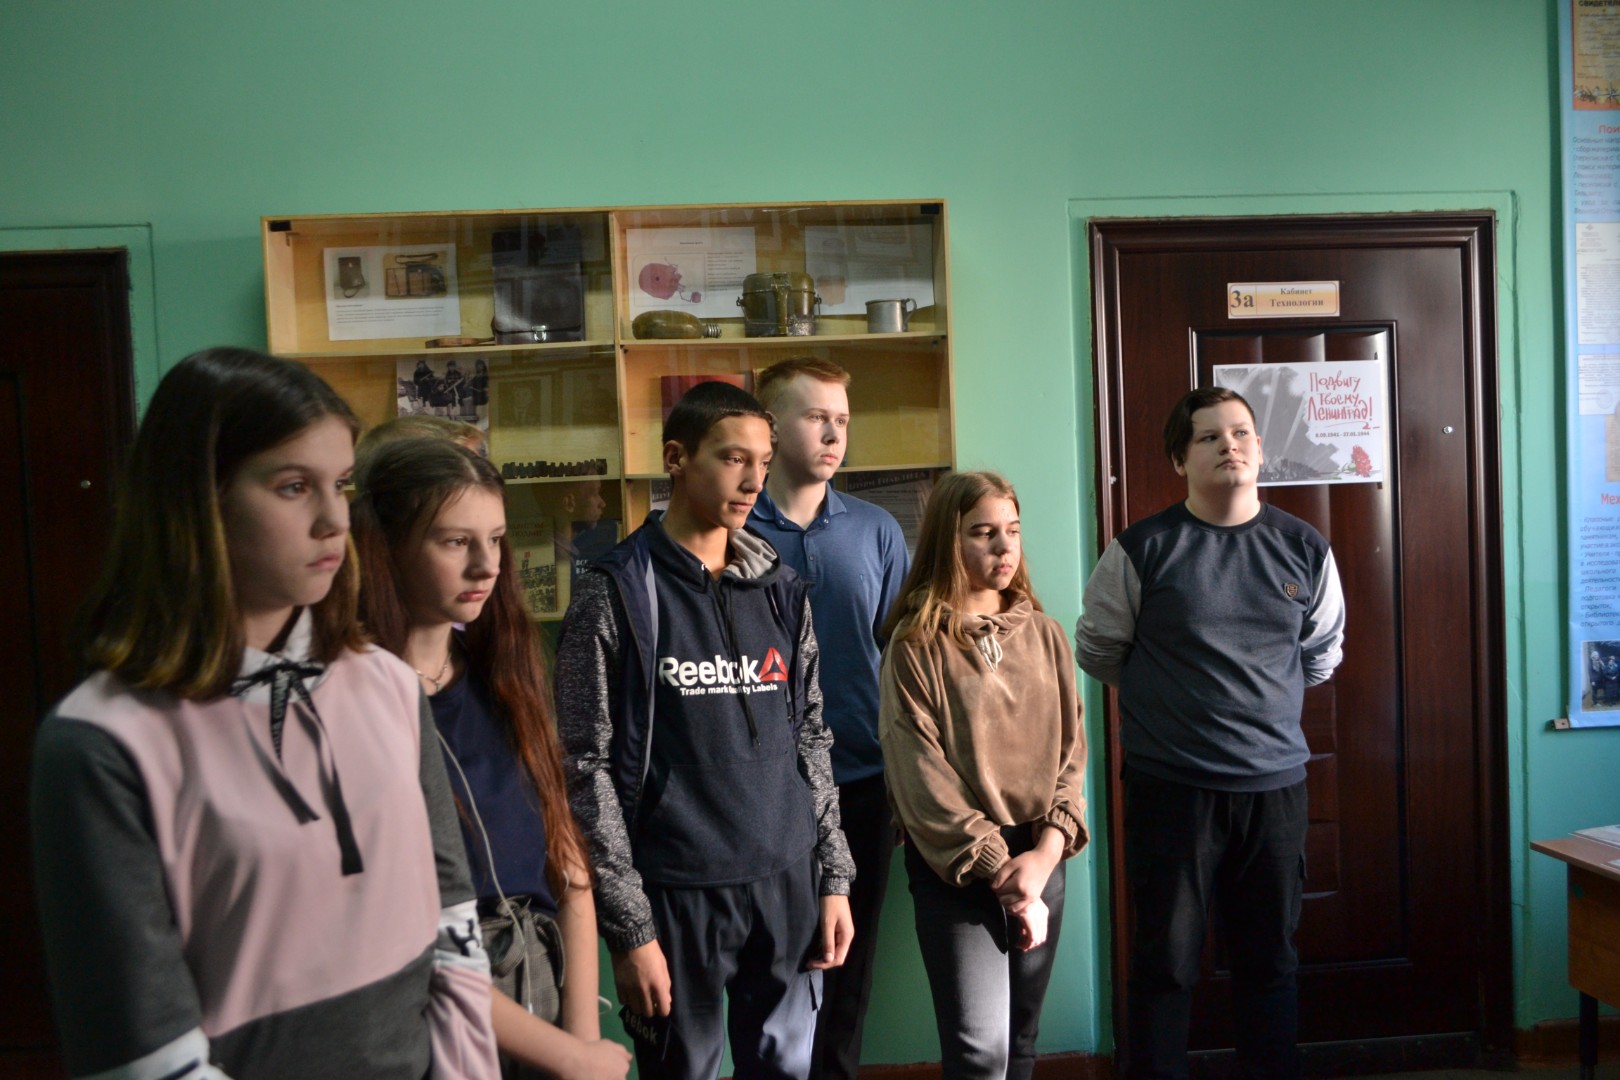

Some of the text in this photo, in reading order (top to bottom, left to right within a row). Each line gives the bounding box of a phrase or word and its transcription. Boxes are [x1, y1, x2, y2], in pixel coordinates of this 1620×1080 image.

[1270, 299, 1323, 307] Технологии
[1310, 370, 1361, 392] Подвигу
[658, 655, 761, 686] Reebok
[680, 687, 706, 696] Trade
[708, 685, 728, 694] mark
[752, 683, 778, 692] Labels
